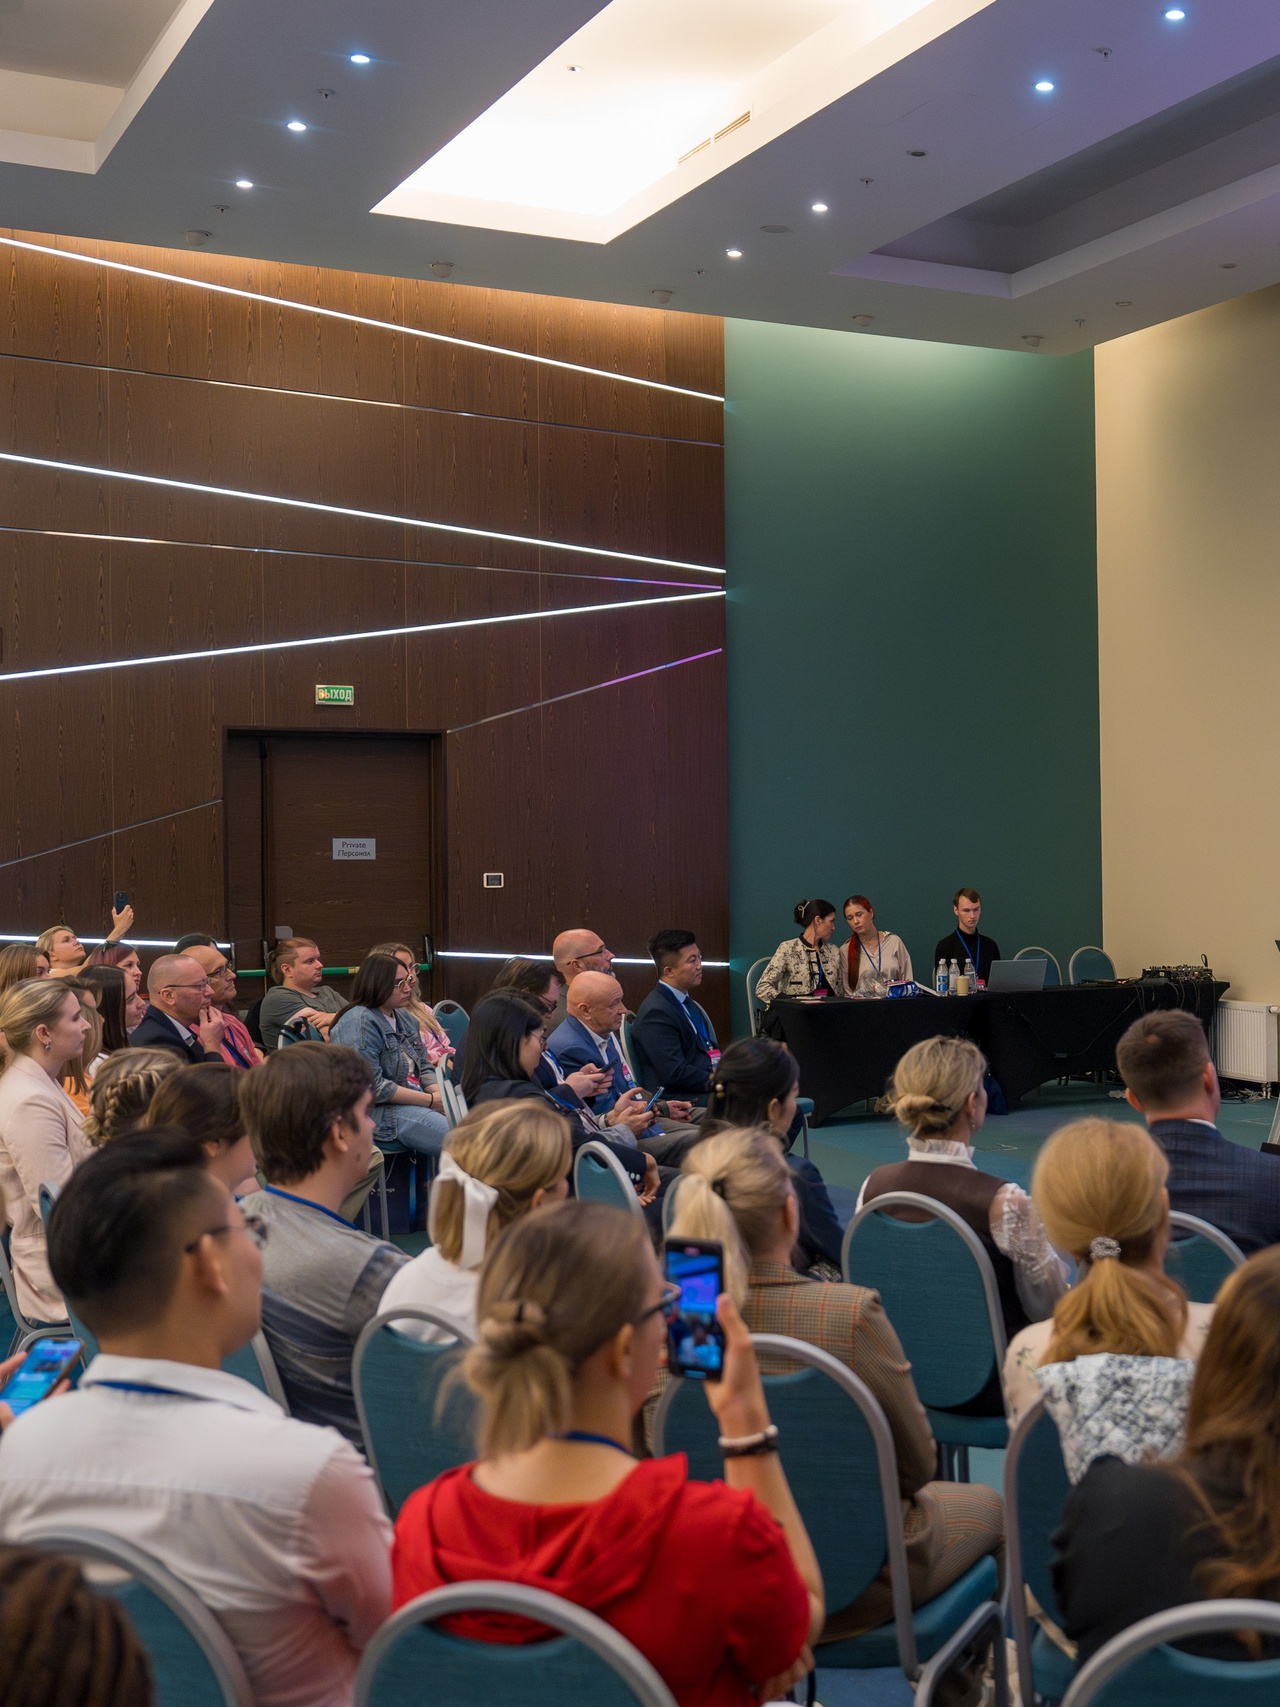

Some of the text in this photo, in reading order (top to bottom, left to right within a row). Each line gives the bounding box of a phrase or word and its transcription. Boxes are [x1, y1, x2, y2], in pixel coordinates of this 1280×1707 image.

[318, 688, 352, 702] ВЫХОД
[341, 841, 367, 849] Private
[337, 849, 371, 859] Персонал
